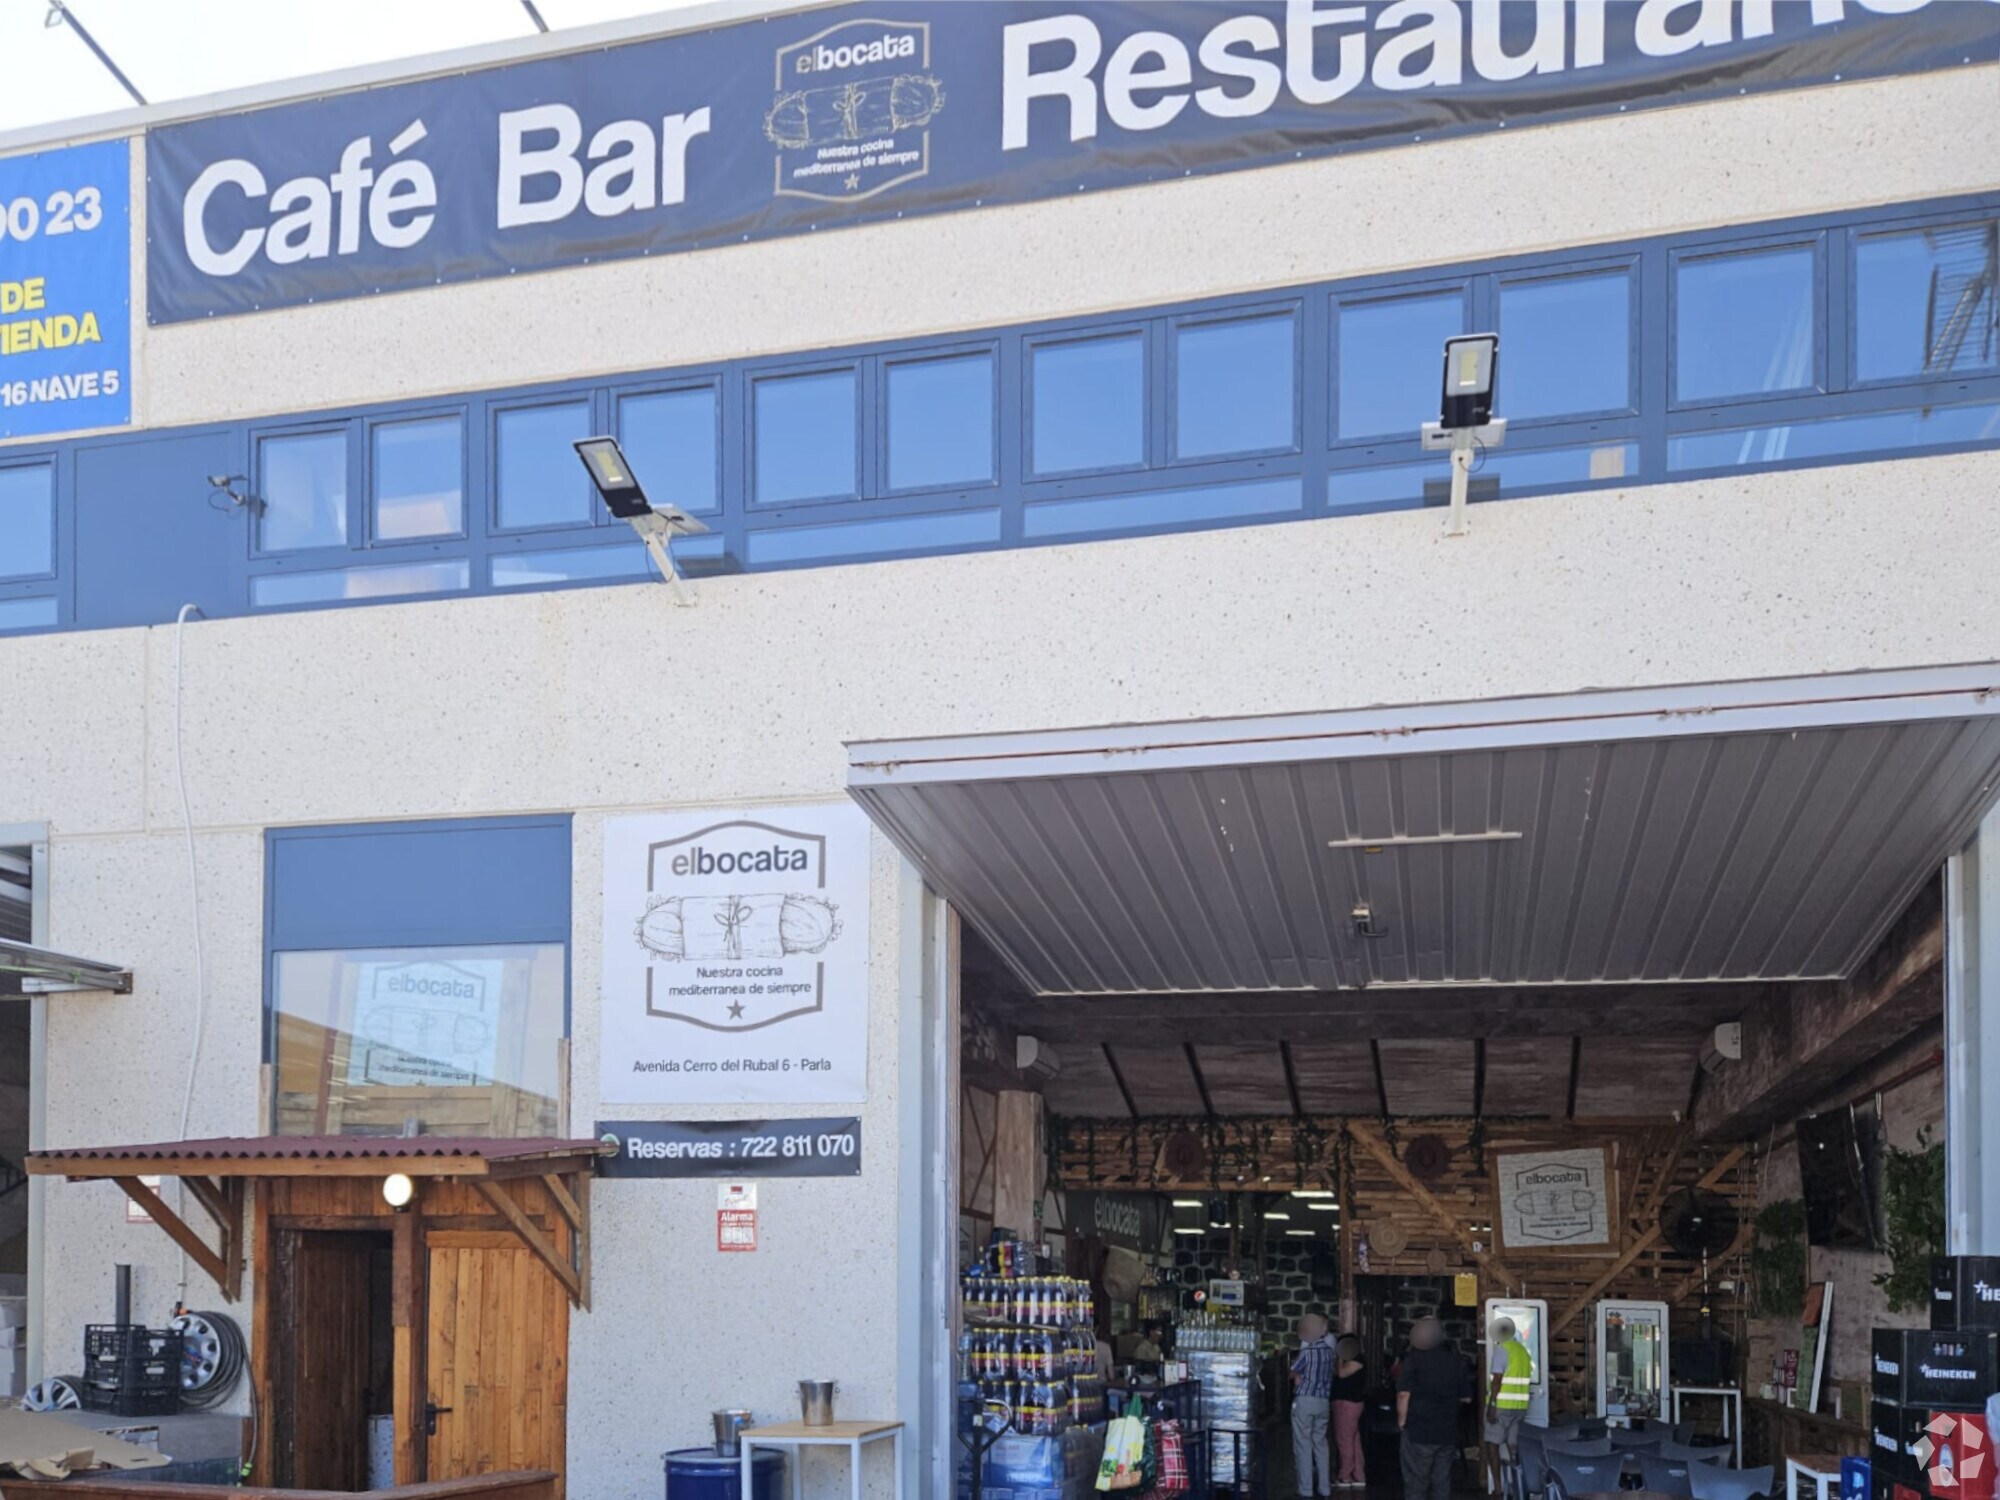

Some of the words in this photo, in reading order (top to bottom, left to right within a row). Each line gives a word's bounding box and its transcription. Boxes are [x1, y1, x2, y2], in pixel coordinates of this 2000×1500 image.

[796, 34, 915, 74] elbocata
[183, 119, 437, 277] Café
[497, 103, 711, 229] Bar
[1002, 0, 2000, 151] Restaura
[862, 154, 876, 167] de
[878, 150, 919, 166] siempre
[45, 186, 103, 236] 23
[0, 277, 45, 314] DE
[0, 312, 102, 355] IENDA
[0, 381, 28, 407] 16
[29, 371, 99, 403] NAVE
[102, 370, 120, 395] 5
[671, 845, 808, 876] elbocata
[697, 966, 743, 979] Nuestra
[746, 965, 783, 977] cocina
[668, 983, 746, 996] mediterranea
[749, 982, 764, 994] de
[766, 982, 812, 996] siempre
[632, 1060, 680, 1073] Avenida
[683, 1059, 718, 1072] Cerro
[720, 1059, 740, 1072] del
[743, 1058, 779, 1072] Rubal
[782, 1059, 790, 1071] 6
[801, 1058, 831, 1071] Parla
[627, 1137, 722, 1159] Reservas
[740, 1136, 777, 1158] 722
[782, 1136, 811, 1157] 811
[817, 1135, 855, 1157] 070
[1525, 1172, 1581, 1185] elbocata
[720, 1211, 754, 1222] Alarma
[1924, 1368, 1977, 1381] HEINEKEN
